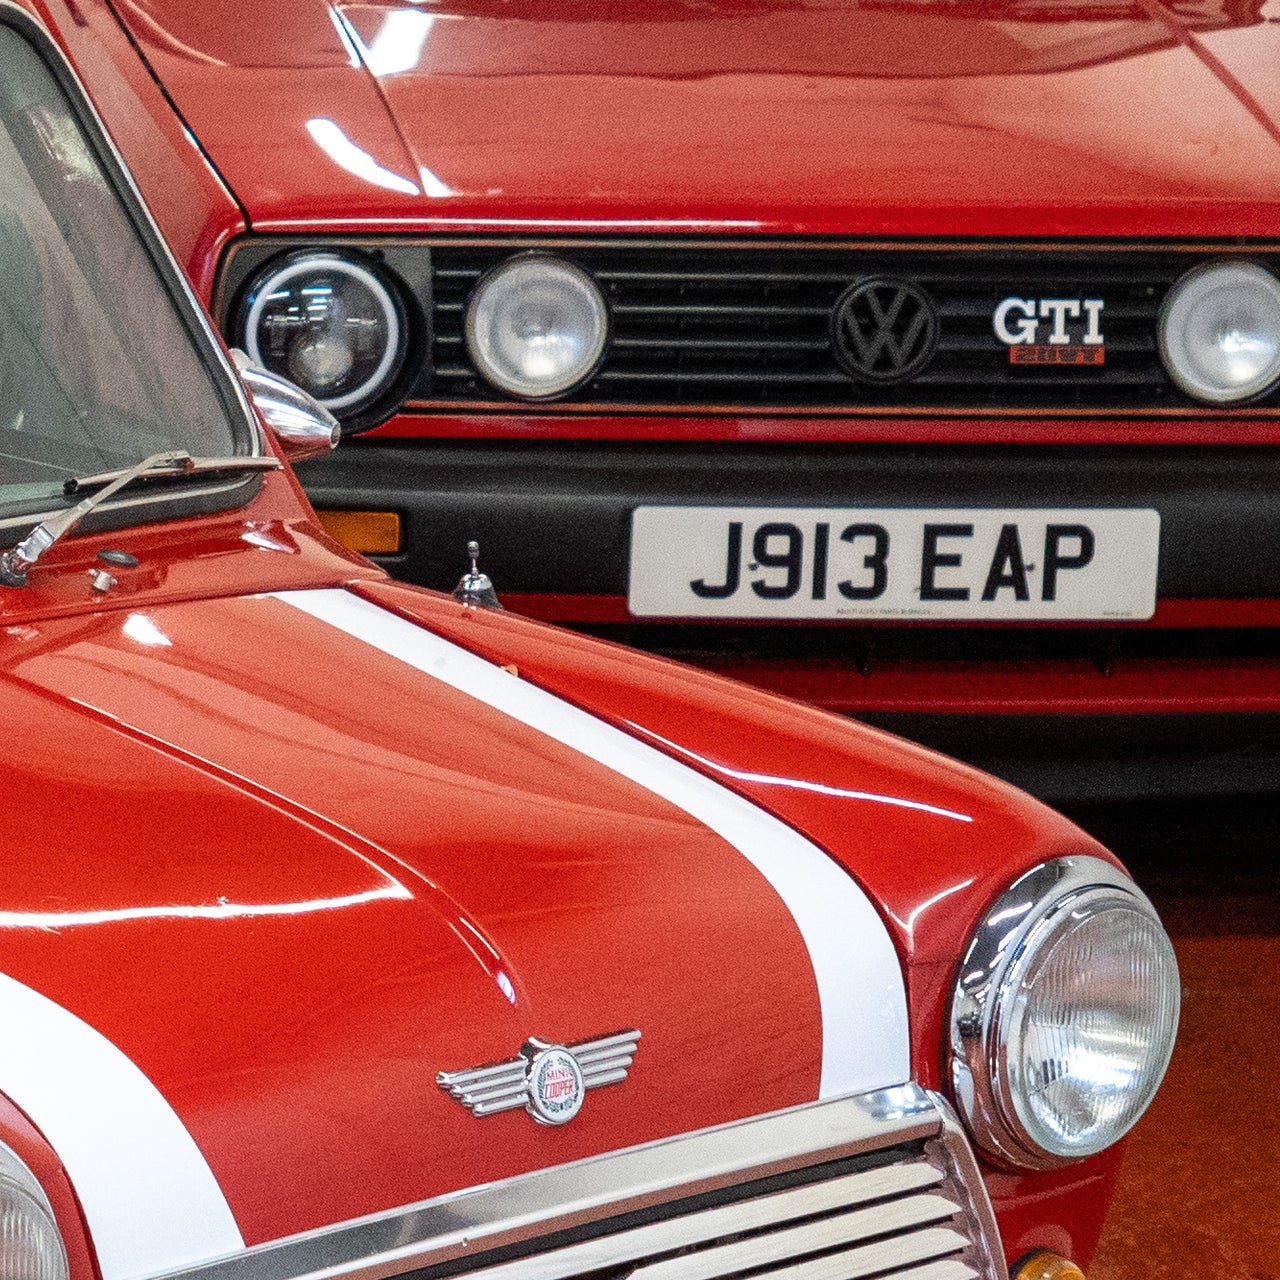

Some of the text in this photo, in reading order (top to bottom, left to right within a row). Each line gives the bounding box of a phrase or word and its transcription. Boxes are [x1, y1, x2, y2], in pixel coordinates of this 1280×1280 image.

[993, 296, 1104, 345] GTI
[690, 522, 1096, 601] J913 EAP
[544, 1078, 574, 1100] COOPER
[545, 1068, 571, 1083] MINI
